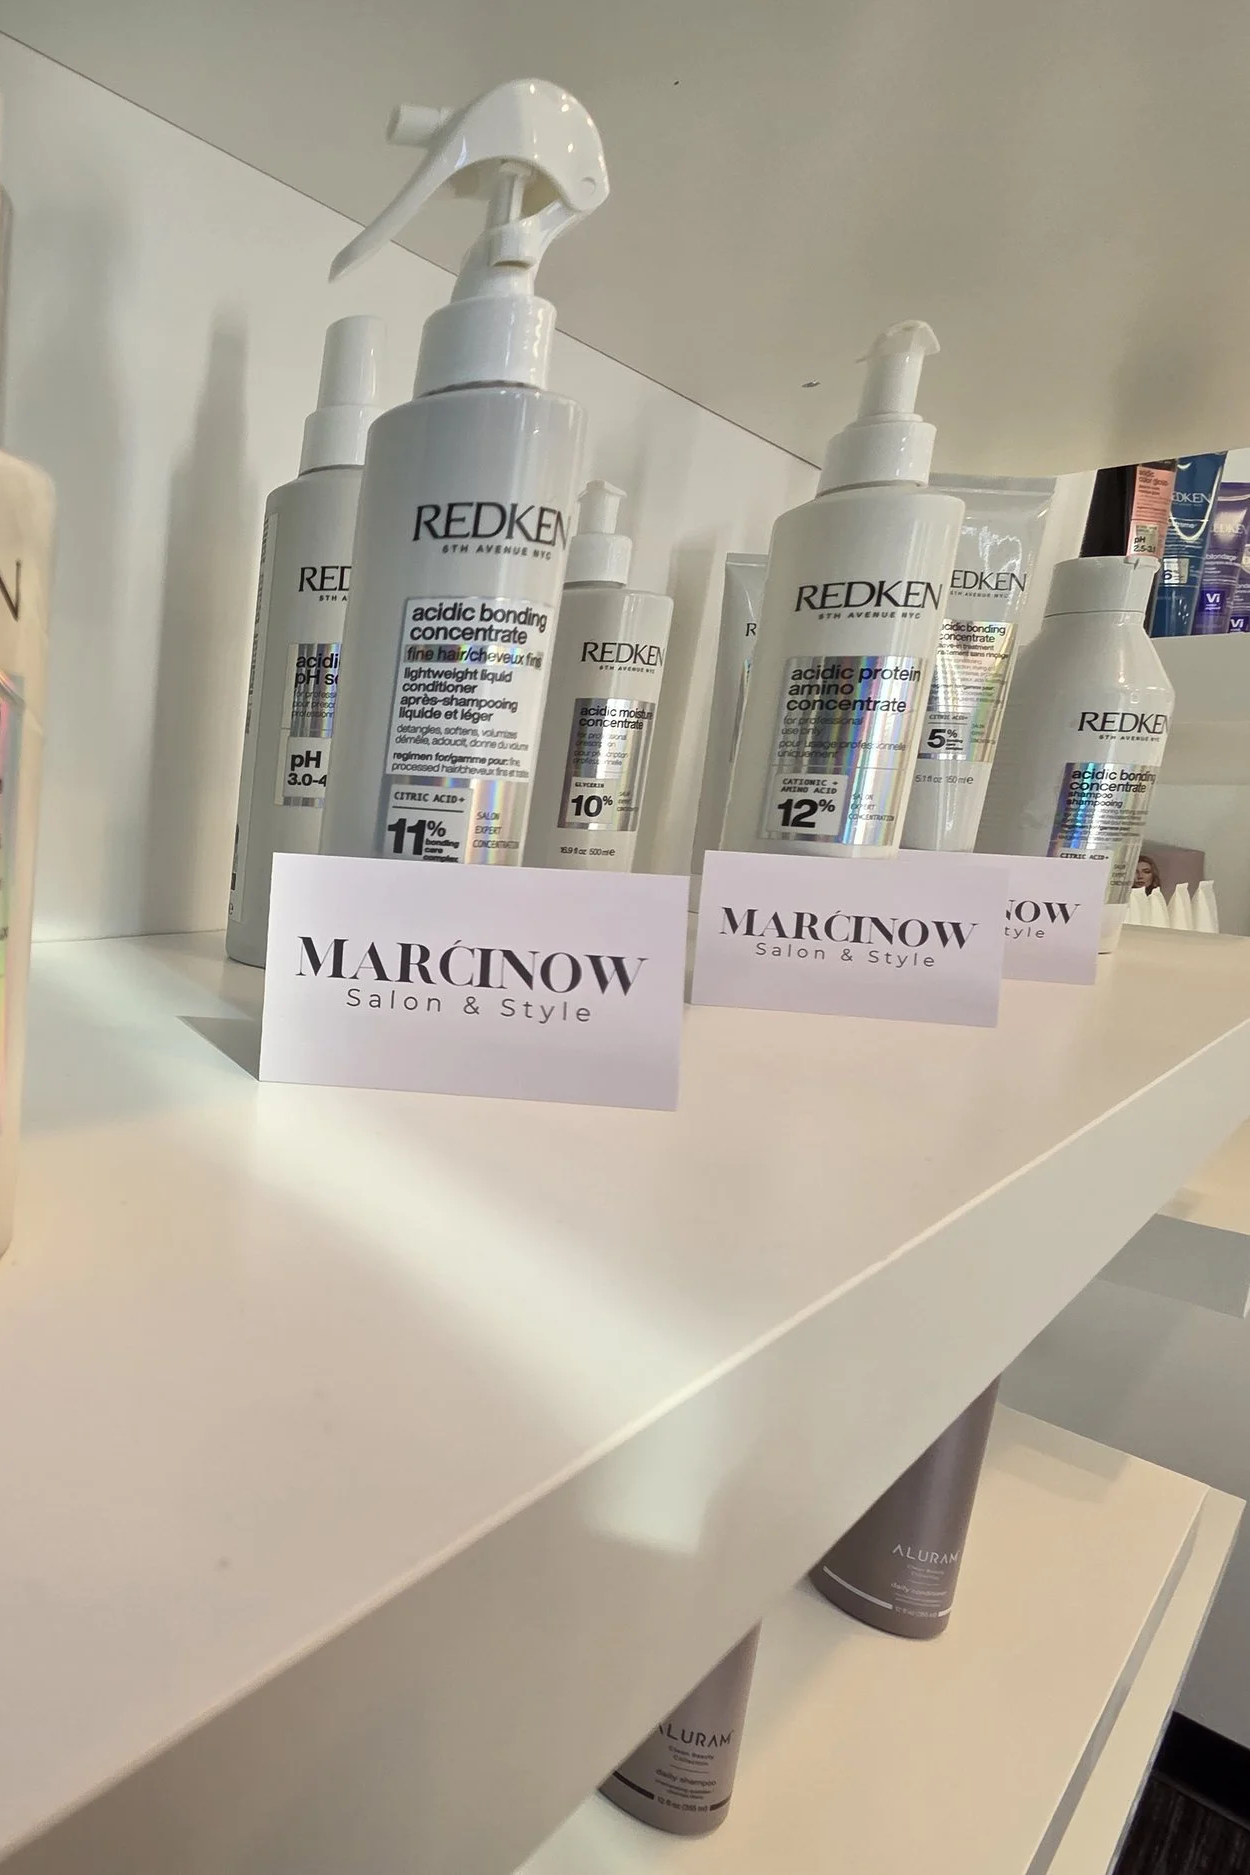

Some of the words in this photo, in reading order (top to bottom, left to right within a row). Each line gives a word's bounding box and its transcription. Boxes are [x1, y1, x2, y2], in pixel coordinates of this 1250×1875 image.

[412, 502, 571, 550] REDKEN
[476, 545, 528, 556] AVENUE
[532, 549, 552, 560] NYC
[950, 570, 1027, 592] EDKEN
[795, 580, 943, 612] REDKEN
[412, 603, 476, 622] acidic
[480, 604, 548, 634] bonding
[847, 611, 896, 619] AVENUE
[410, 624, 528, 645] concentrate
[966, 622, 1006, 636] bonding
[296, 653, 341, 669] acidi
[407, 647, 434, 662] fine
[437, 647, 524, 666] hair/cheveux
[580, 641, 666, 668] REDKEN
[403, 667, 478, 683] lightweight
[480, 669, 512, 684] liquid
[617, 665, 644, 673] AVENUE
[790, 664, 855, 681] acidic
[858, 665, 922, 684] protein
[294, 670, 321, 689] pH
[402, 681, 478, 694] conditioner
[788, 680, 855, 696] amino
[400, 694, 518, 713] après-shampooing
[786, 696, 907, 713] concentrate
[399, 707, 442, 721] liquide
[444, 708, 457, 719] et
[460, 708, 493, 724] léger
[580, 705, 617, 717] acidic
[619, 708, 654, 721] moisture
[579, 717, 644, 730] concentrate
[1078, 711, 1169, 736] REDKEN
[291, 750, 322, 771] pH
[393, 751, 432, 762] regimen
[434, 752, 487, 764] for/gamme
[391, 762, 440, 773] processed
[1072, 768, 1117, 781] acidic
[781, 786, 809, 794] AMINO
[813, 786, 838, 795] ACID
[782, 778, 827, 787] CATIONIC
[1069, 780, 1147, 793] concentrate
[394, 791, 429, 802] CITRIC
[1068, 791, 1113, 799] shampoo
[1066, 798, 1123, 809] shampooing
[425, 838, 460, 849] bonding
[476, 811, 500, 821] SALON
[474, 825, 503, 835] EXPERT
[422, 854, 459, 863] complex
[718, 906, 980, 950] MARĆINOW
[755, 942, 826, 962] Salon
[840, 948, 854, 963] &
[867, 949, 936, 969] Style
[295, 935, 649, 998] MARĆINOW
[346, 988, 442, 1013] Salon
[463, 996, 481, 1016] &
[500, 998, 592, 1025] Style
[892, 1543, 960, 1565] ALURAM
[679, 1776, 717, 1788] shampoo
